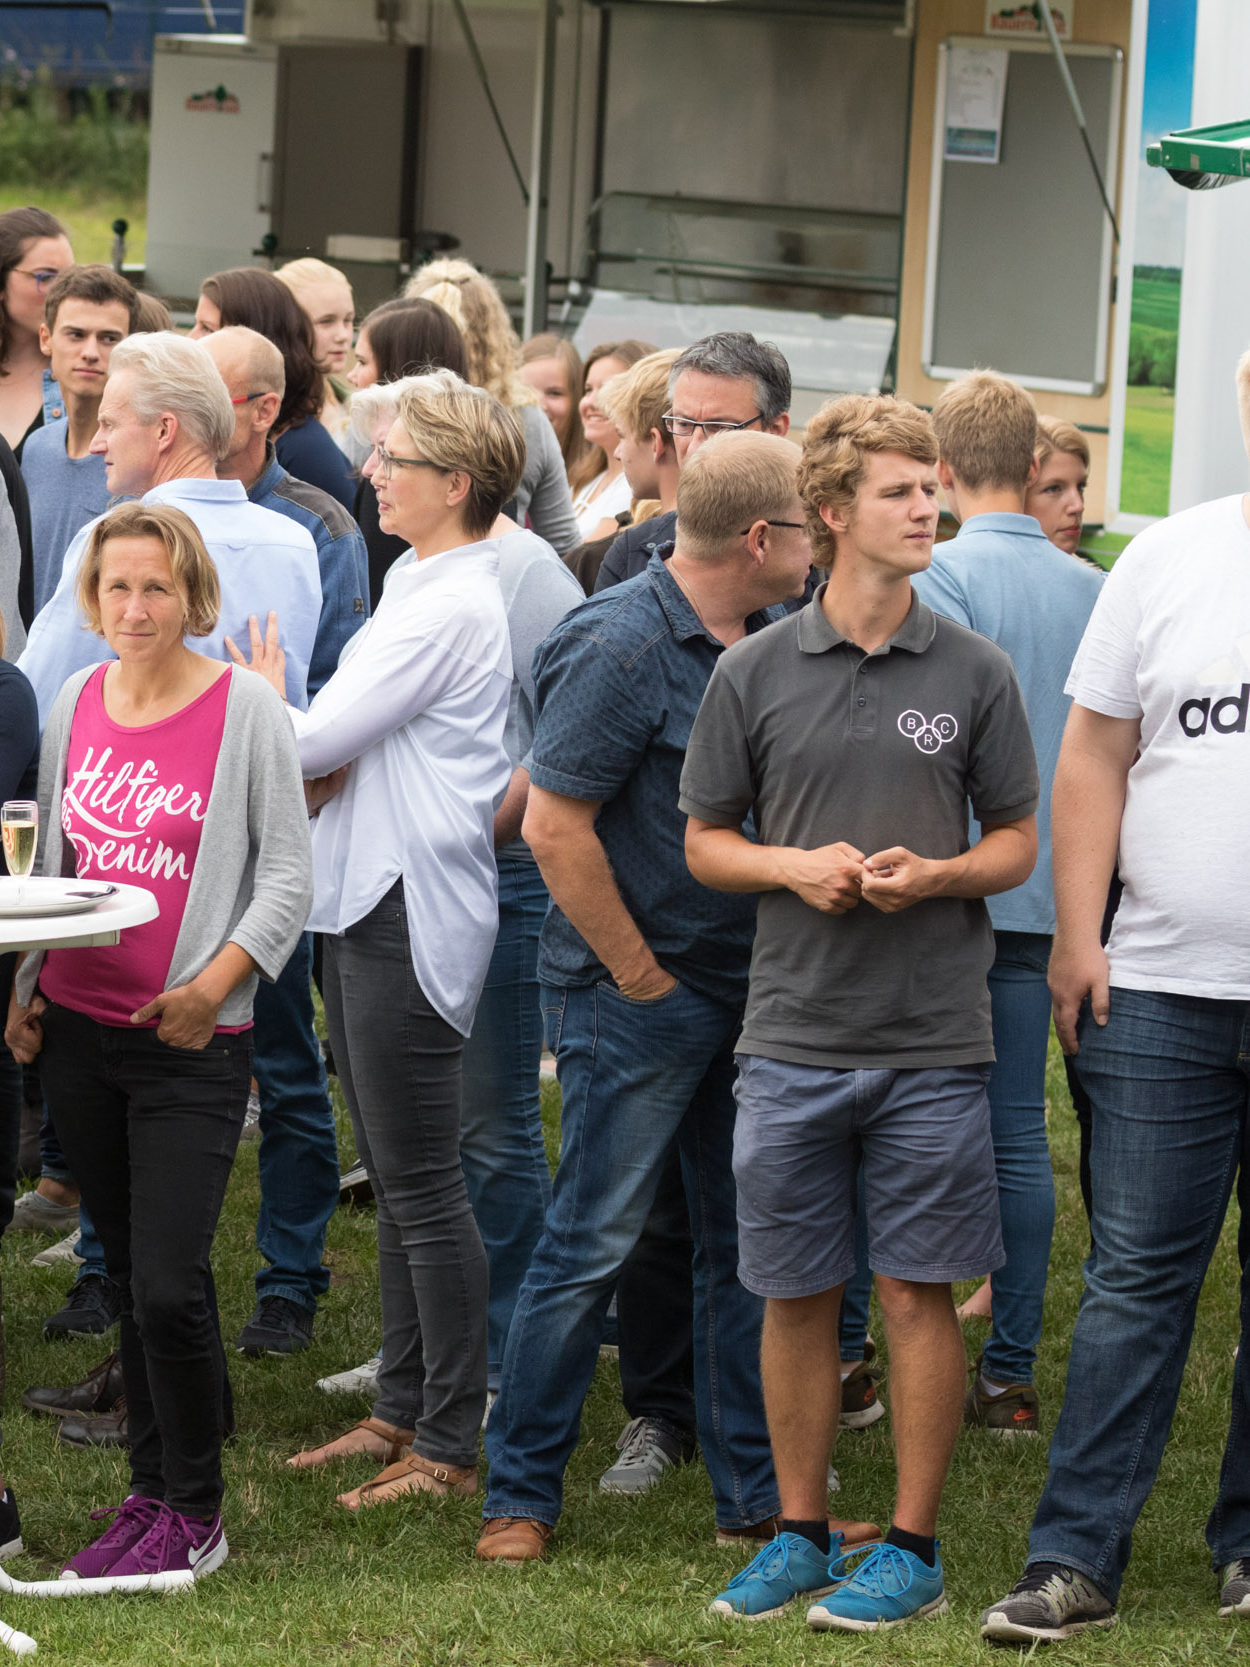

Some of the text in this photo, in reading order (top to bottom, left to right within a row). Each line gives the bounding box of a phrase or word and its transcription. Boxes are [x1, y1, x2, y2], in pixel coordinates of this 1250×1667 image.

[1178, 683, 1250, 738] ad
[64, 746, 207, 832] Hilfiger
[66, 832, 191, 880] Denim
